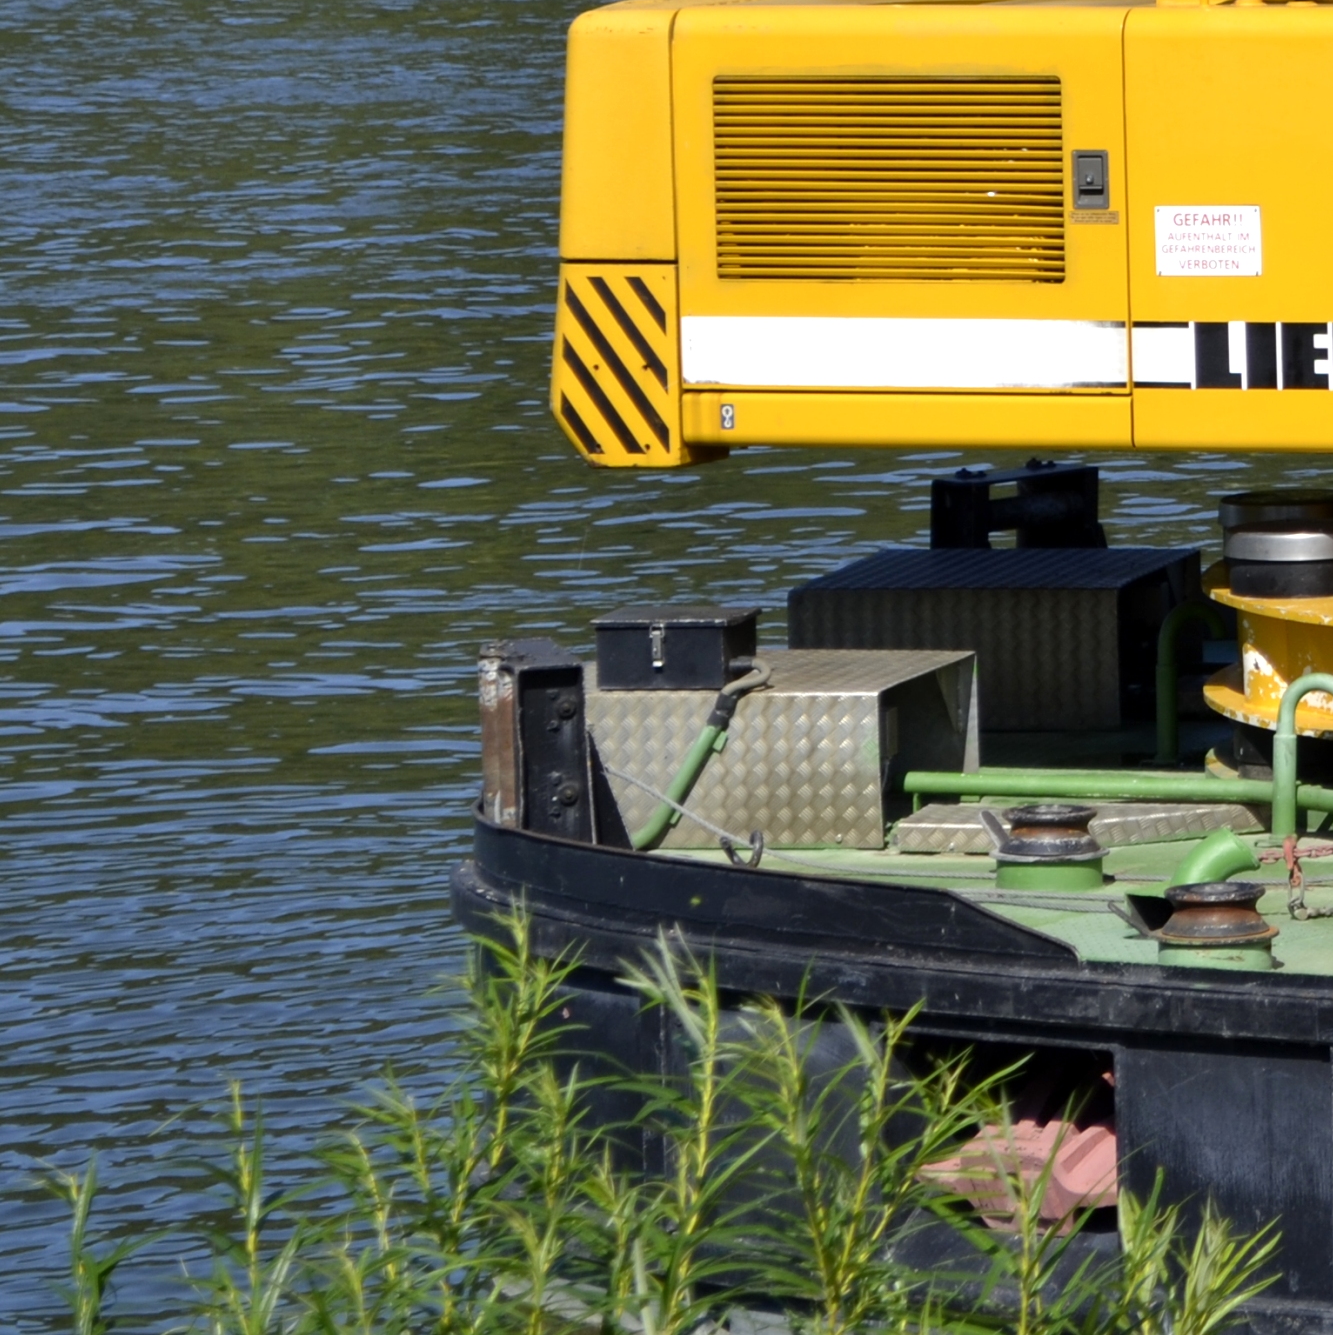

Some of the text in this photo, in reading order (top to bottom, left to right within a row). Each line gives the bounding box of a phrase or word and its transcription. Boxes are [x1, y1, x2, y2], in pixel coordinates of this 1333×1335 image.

[1173, 213, 1243, 227] GEFAHR!!
[1167, 232, 1250, 241] AUFENTHALT IM
[1161, 244, 1256, 254] GEFAHRENBEREICH
[1178, 259, 1240, 269] VERBOTEN
